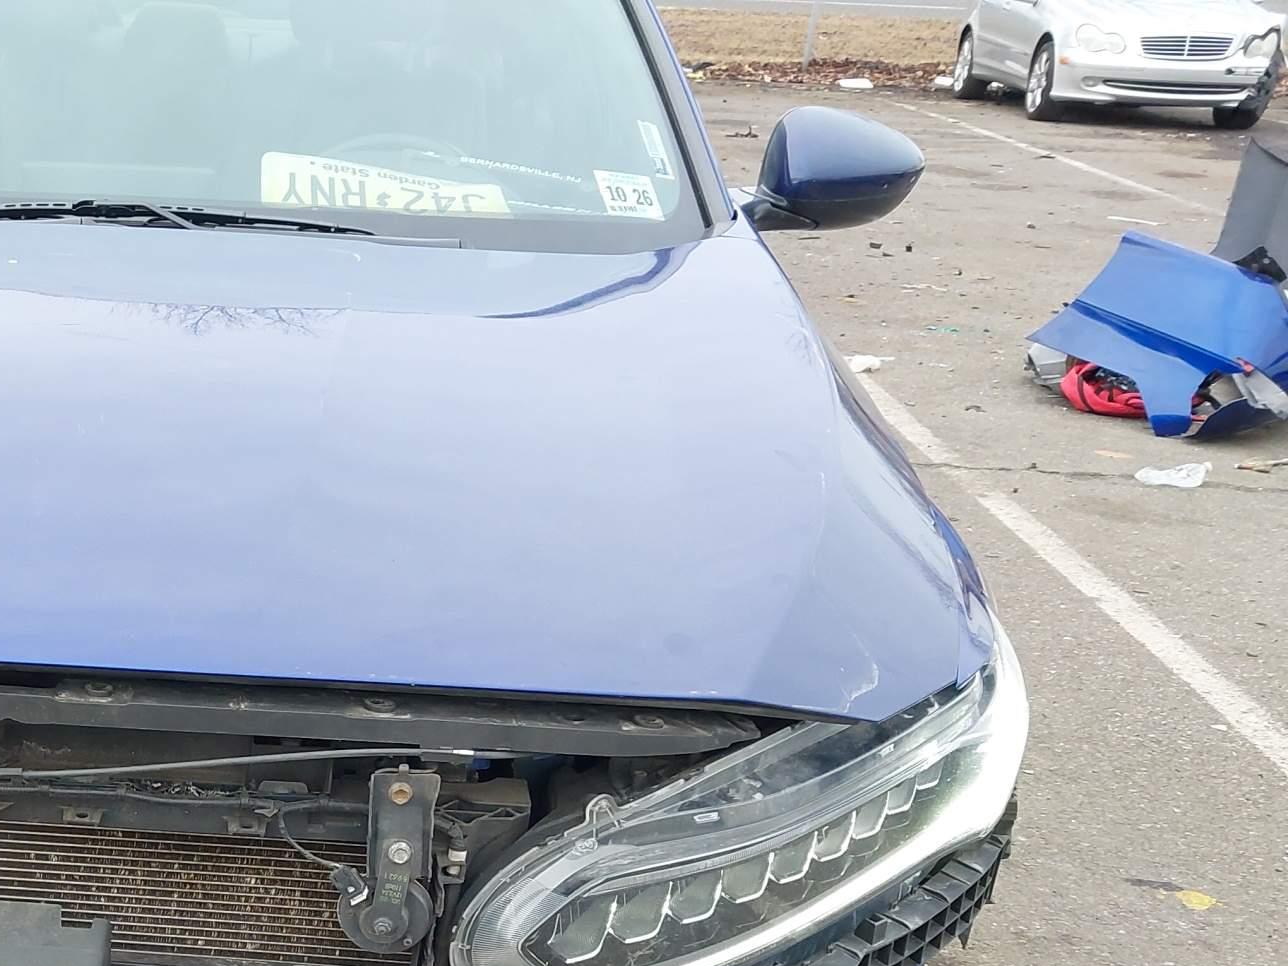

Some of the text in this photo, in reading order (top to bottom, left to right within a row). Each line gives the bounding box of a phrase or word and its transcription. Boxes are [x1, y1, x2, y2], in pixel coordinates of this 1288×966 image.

[322, 162, 440, 190] Garden State
[566, 175, 582, 183] NJ
[282, 172, 368, 209] RNY
[399, 186, 486, 215] J42
[605, 186, 654, 206] 10 26
